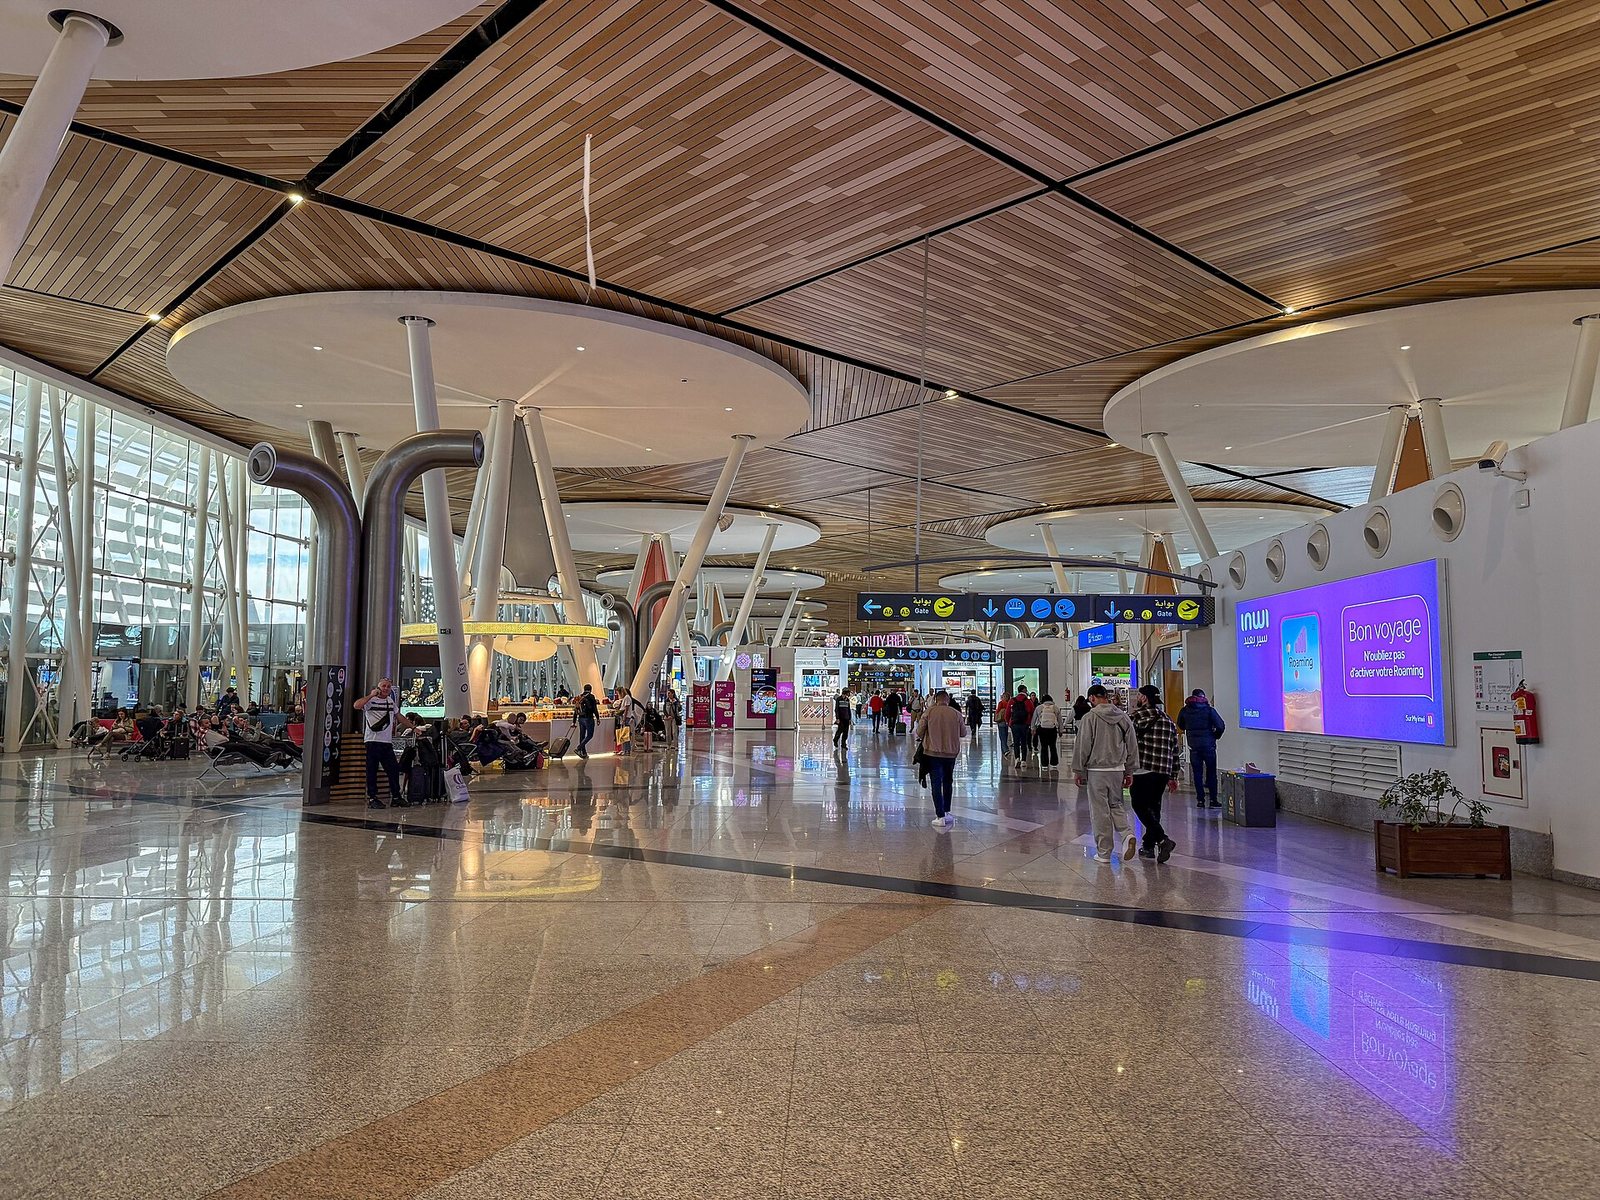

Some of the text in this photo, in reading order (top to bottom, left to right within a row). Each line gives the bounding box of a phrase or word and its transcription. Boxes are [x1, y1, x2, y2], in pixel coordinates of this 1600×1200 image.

[913, 597, 932, 606] بوابة
[1155, 599, 1175, 609] بوابة
[1348, 618, 1421, 644] Bon voyage
[1288, 656, 1314, 670] Roaming
[1363, 649, 1406, 663] N'oubliez pas
[1350, 664, 1424, 679] d'activer votre Roaming
